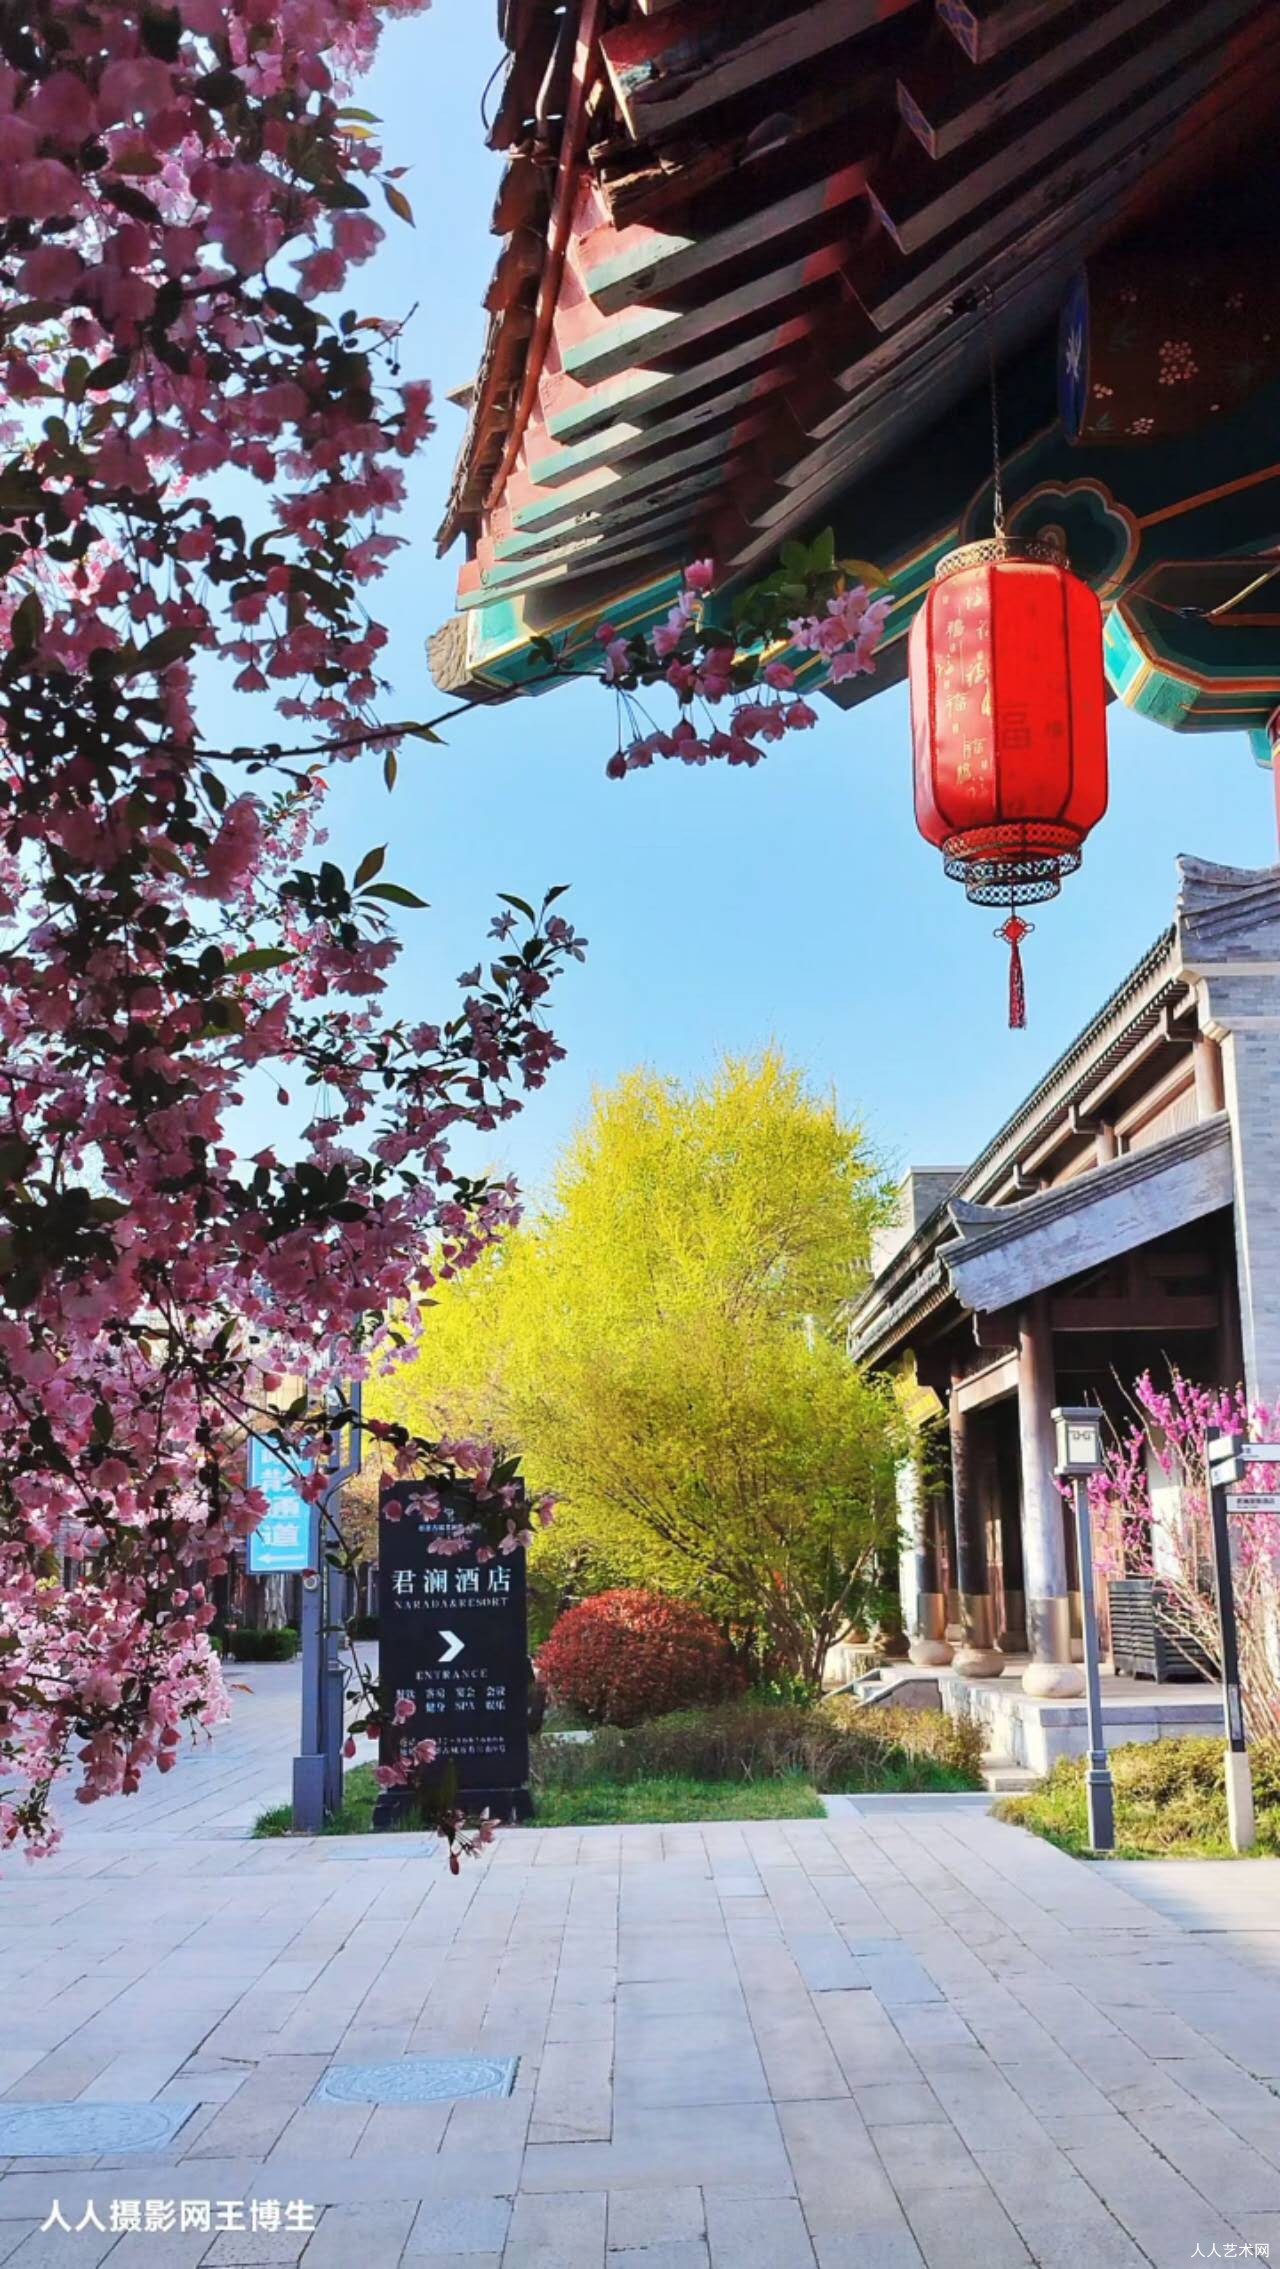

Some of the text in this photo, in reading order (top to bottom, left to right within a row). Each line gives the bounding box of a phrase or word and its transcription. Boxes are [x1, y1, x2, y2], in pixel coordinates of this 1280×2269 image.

[392, 1565, 512, 1594] 君澜酒店
[415, 1668, 488, 1680] ENTRANCE
